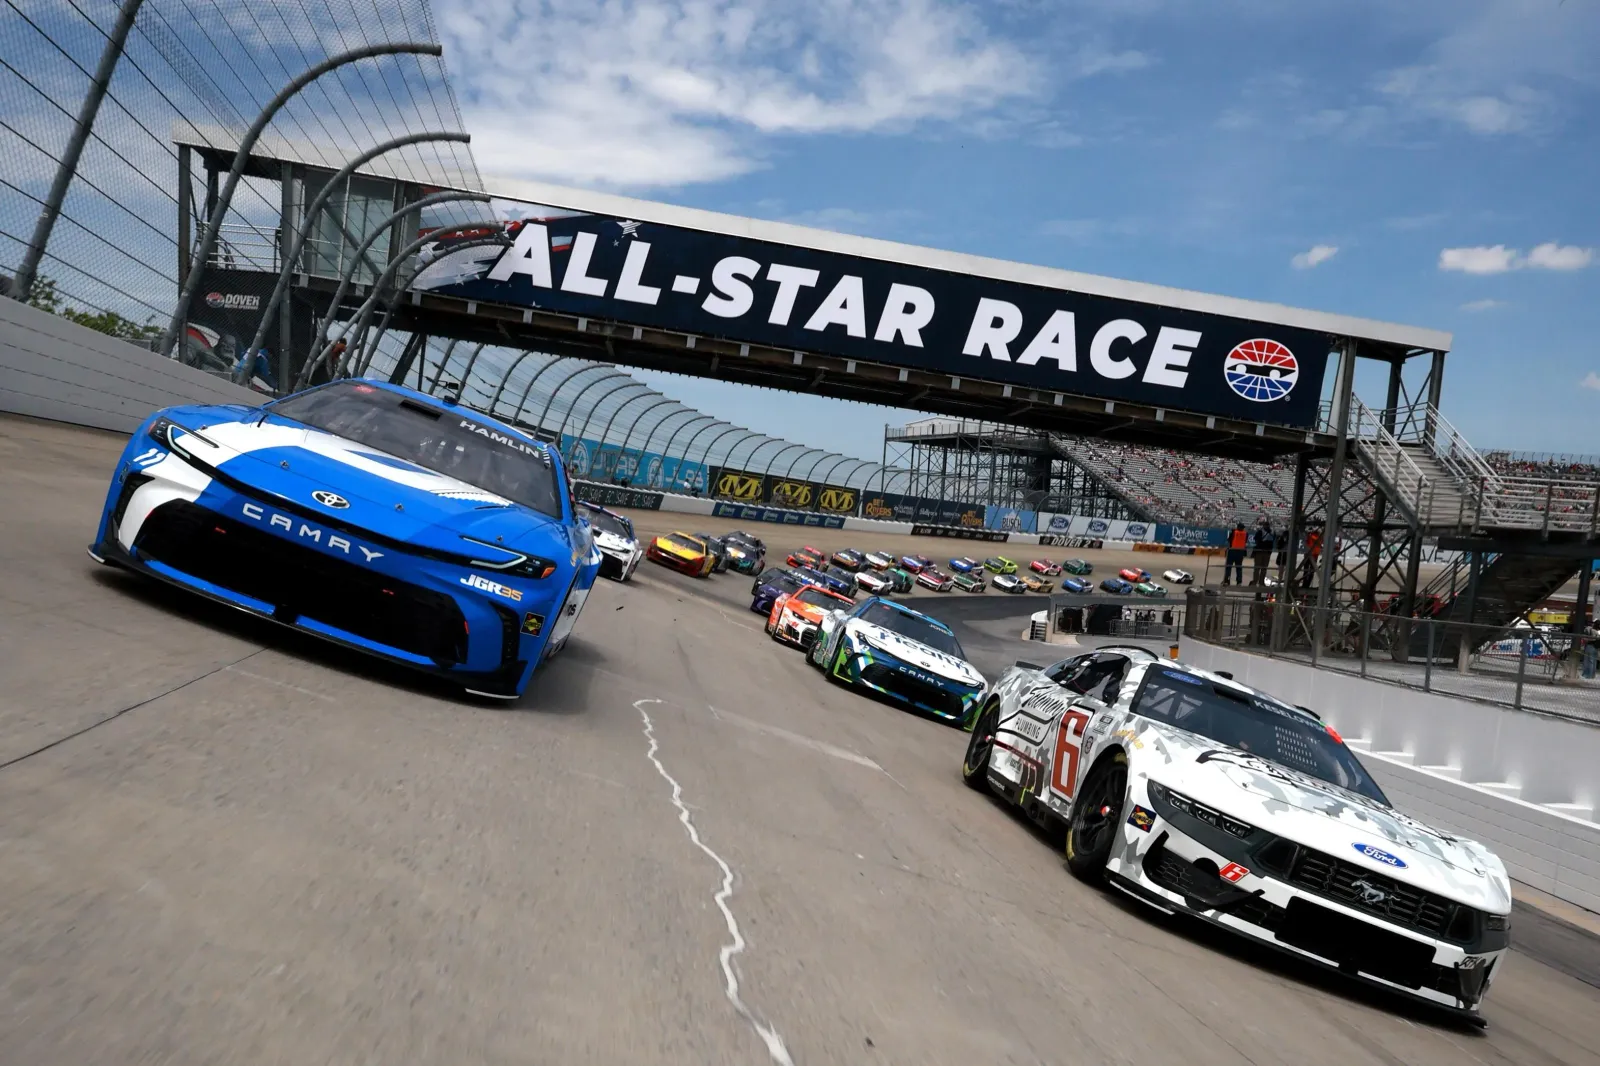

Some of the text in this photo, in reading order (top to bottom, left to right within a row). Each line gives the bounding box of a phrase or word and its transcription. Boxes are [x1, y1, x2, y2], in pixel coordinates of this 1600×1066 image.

[225, 293, 260, 307] DOVER
[487, 222, 1203, 389] ALL-STAR RACE
[459, 420, 541, 459] HAMLIN
[132, 447, 167, 467] 11
[242, 502, 385, 563] CAMRY
[1002, 517, 1022, 529] BUSCH
[1171, 525, 1209, 540] Delaware
[1051, 536, 1092, 548] DOVER 2
[460, 573, 524, 602] JGR35
[898, 665, 945, 687] CAMRY
[1014, 717, 1042, 740] PLUMBING
[1051, 707, 1091, 802] 6
[1363, 844, 1399, 868] Ford
[1219, 862, 1250, 884] 6
